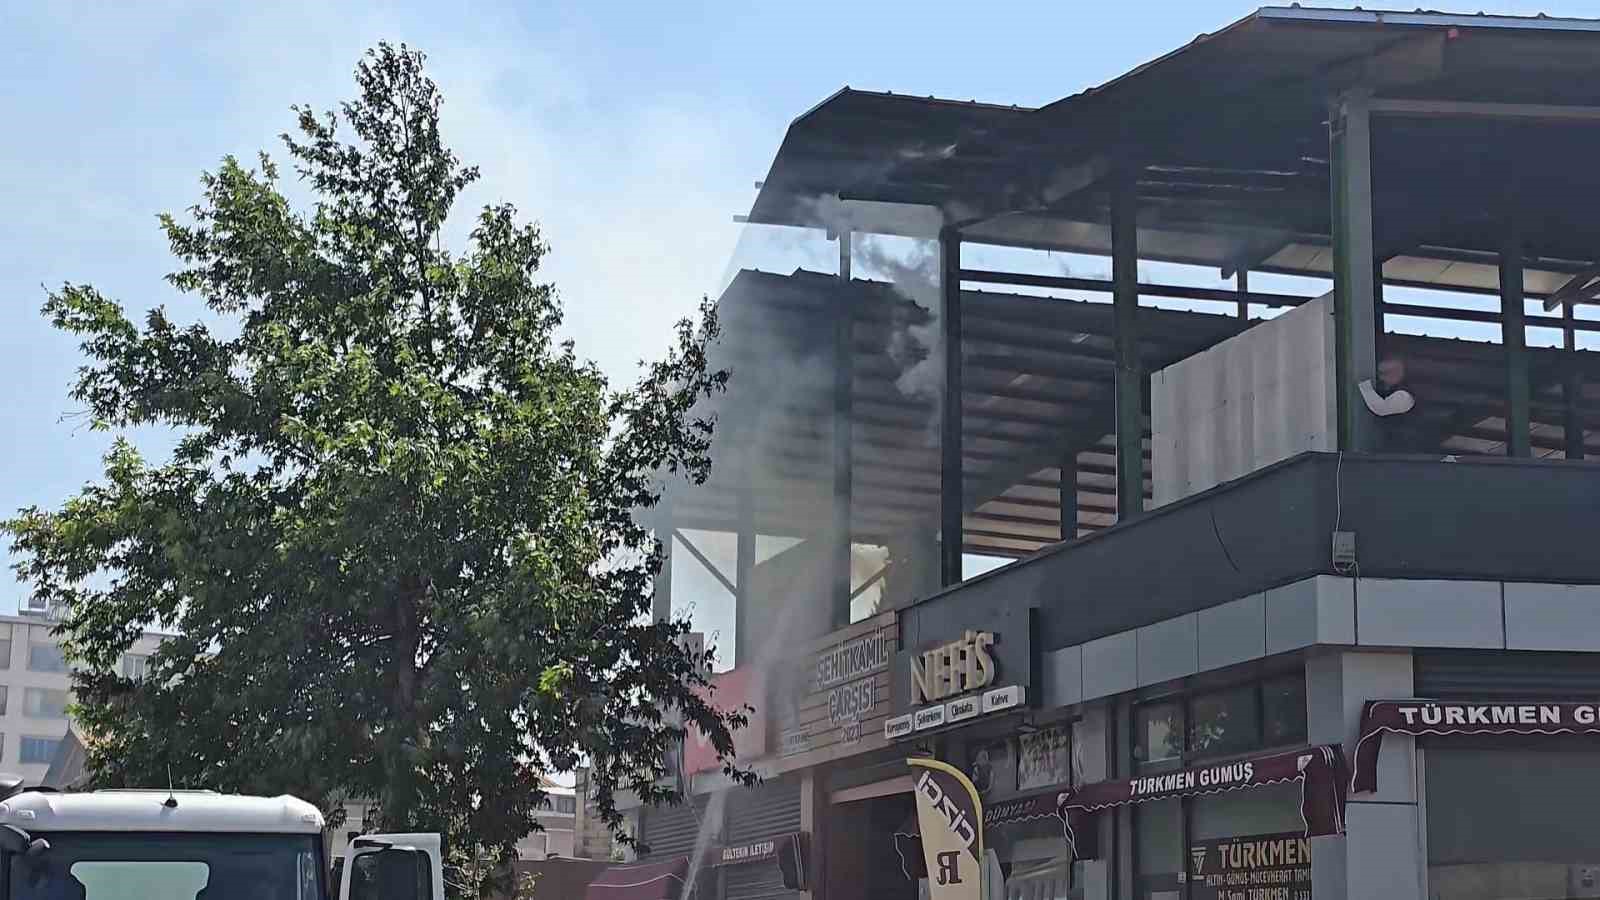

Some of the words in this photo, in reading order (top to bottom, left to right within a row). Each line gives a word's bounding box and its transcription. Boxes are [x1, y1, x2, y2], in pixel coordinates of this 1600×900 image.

[1399, 703, 1561, 725] TÜRKMEN
[1574, 705, 1600, 724] G
[1218, 837, 1311, 869] TÜRKMEN
